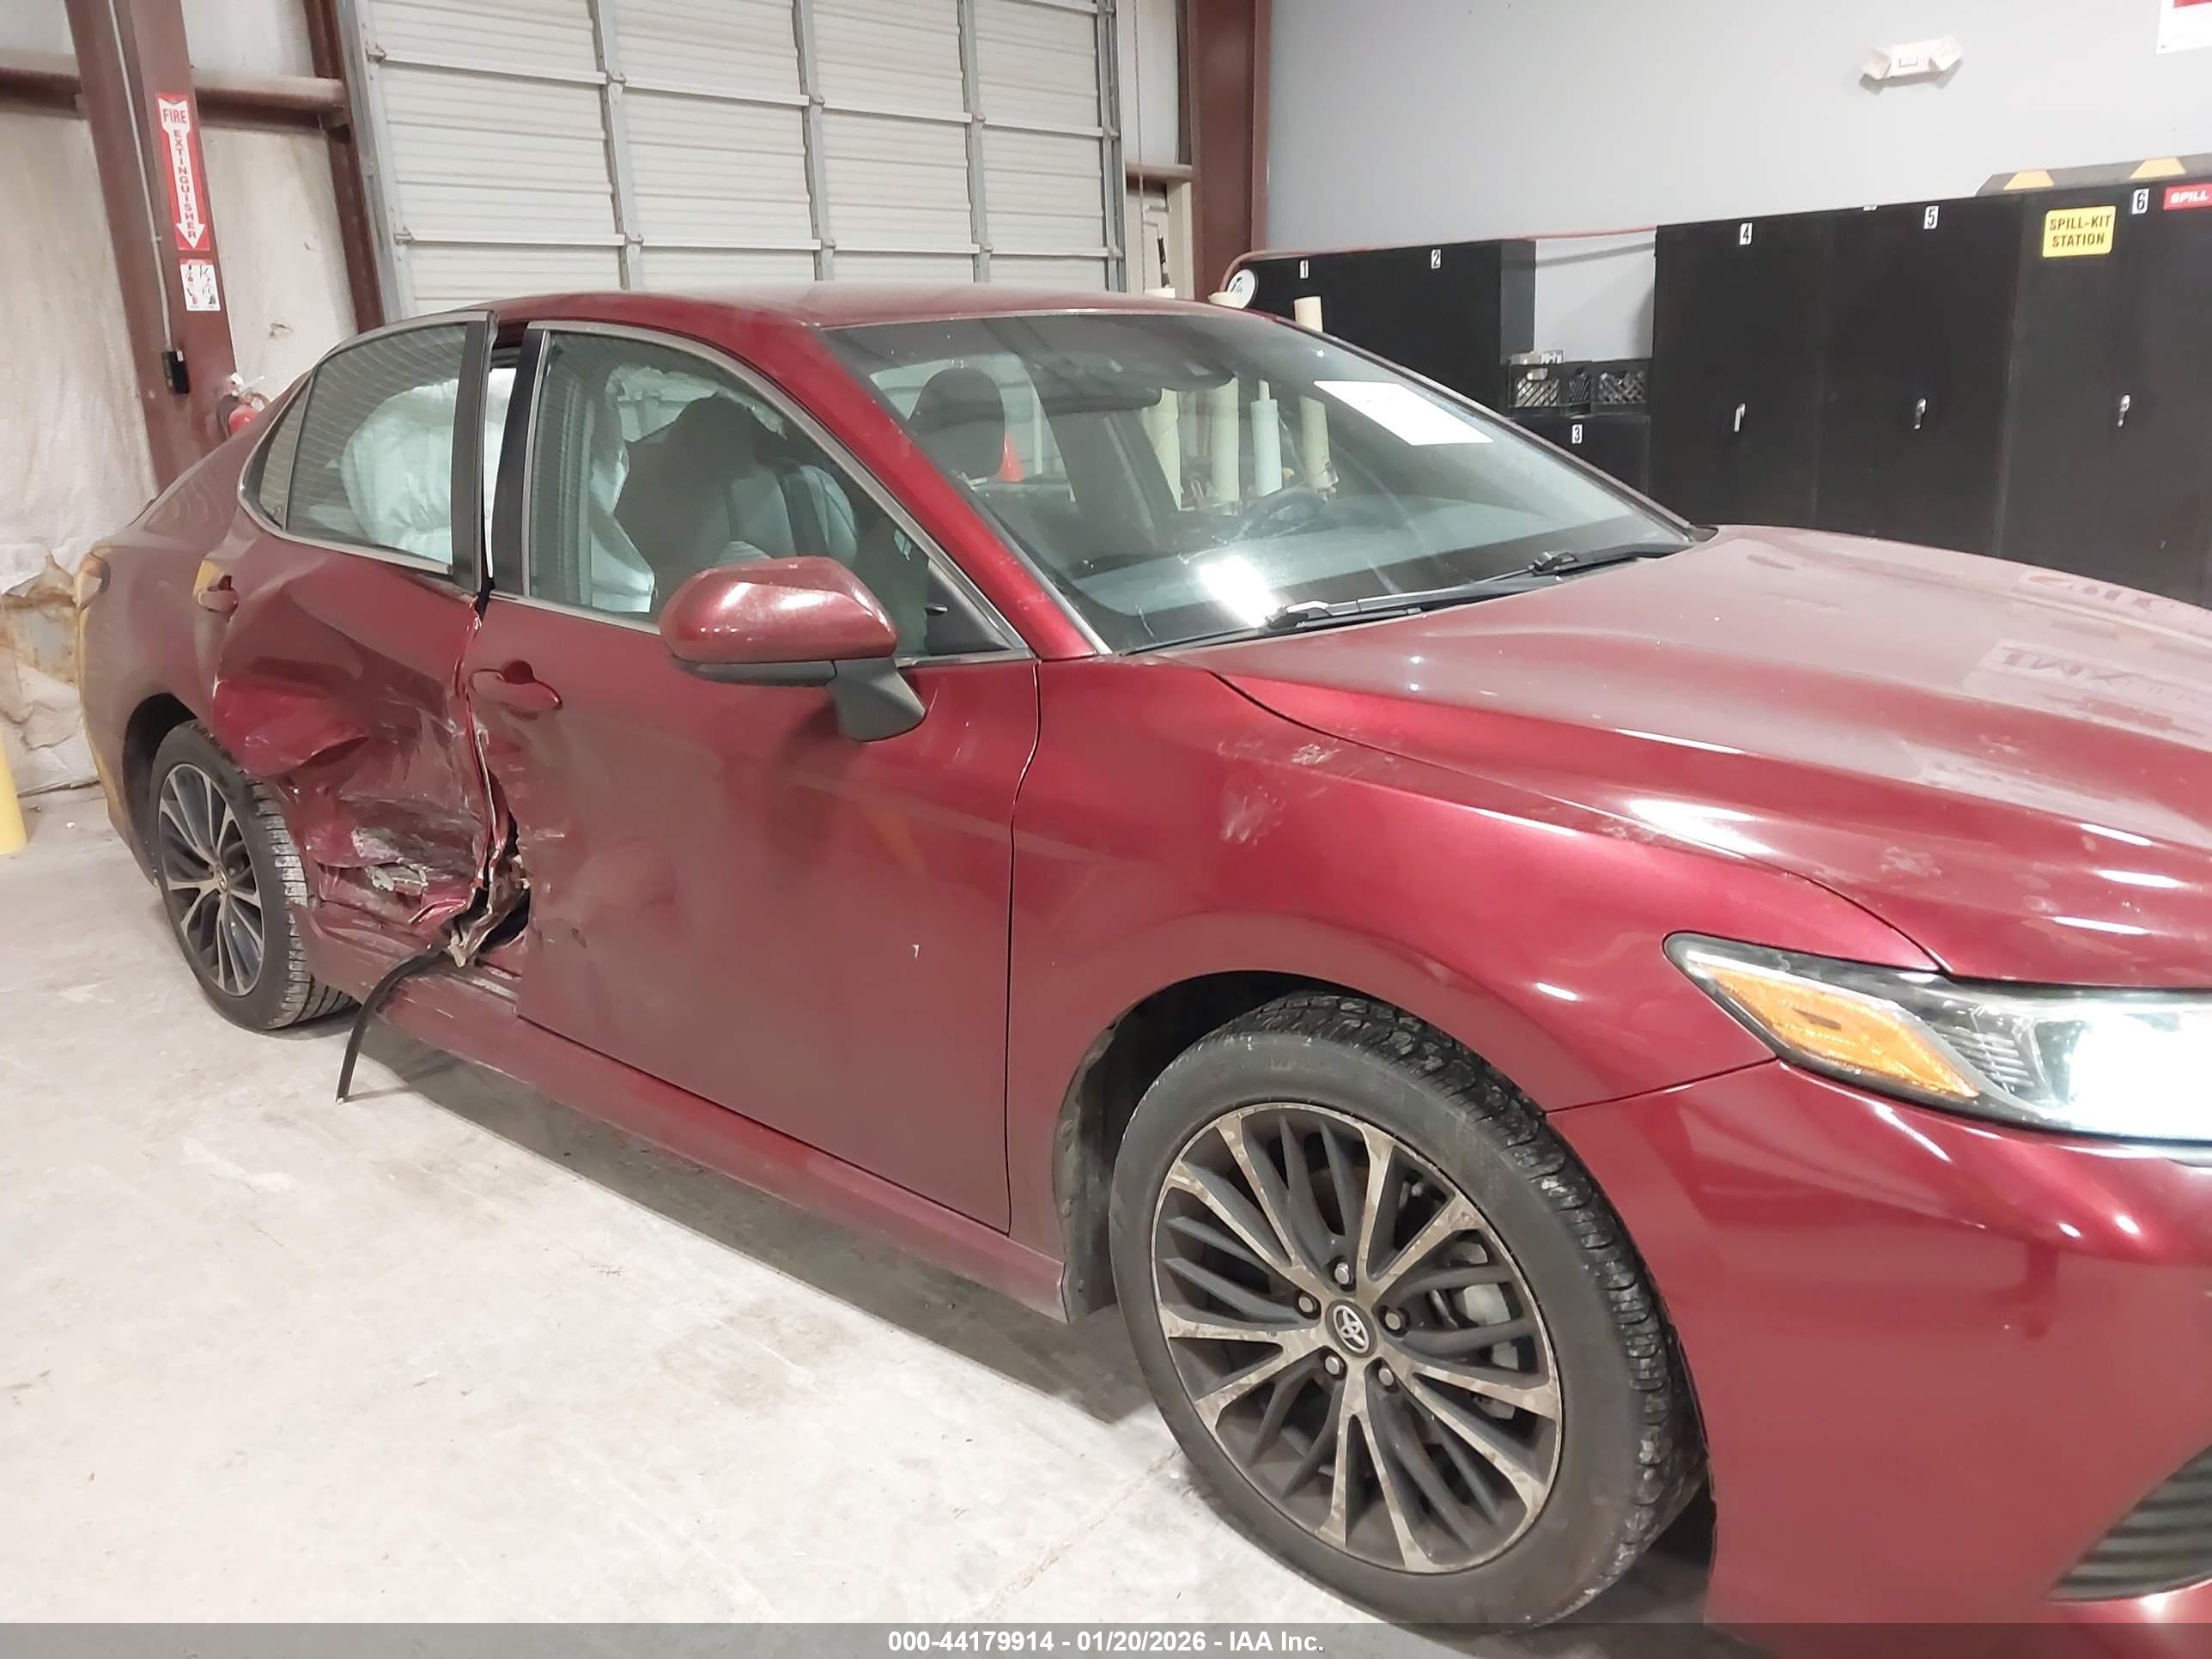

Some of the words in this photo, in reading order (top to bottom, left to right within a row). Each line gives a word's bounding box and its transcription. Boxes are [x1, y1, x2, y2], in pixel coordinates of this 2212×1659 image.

[162, 107, 188, 124] FIRE
[173, 129, 197, 239] EXTINGUISHER
[2136, 192, 2146, 211] 6
[2170, 189, 2209, 204] SPILL
[1927, 207, 1936, 227] 5
[2049, 215, 2112, 231] SPILL-KIT
[1741, 225, 1750, 242] 4
[2051, 232, 2106, 248] STATION
[1432, 251, 1440, 268] 2
[1574, 426, 1580, 441] 3
